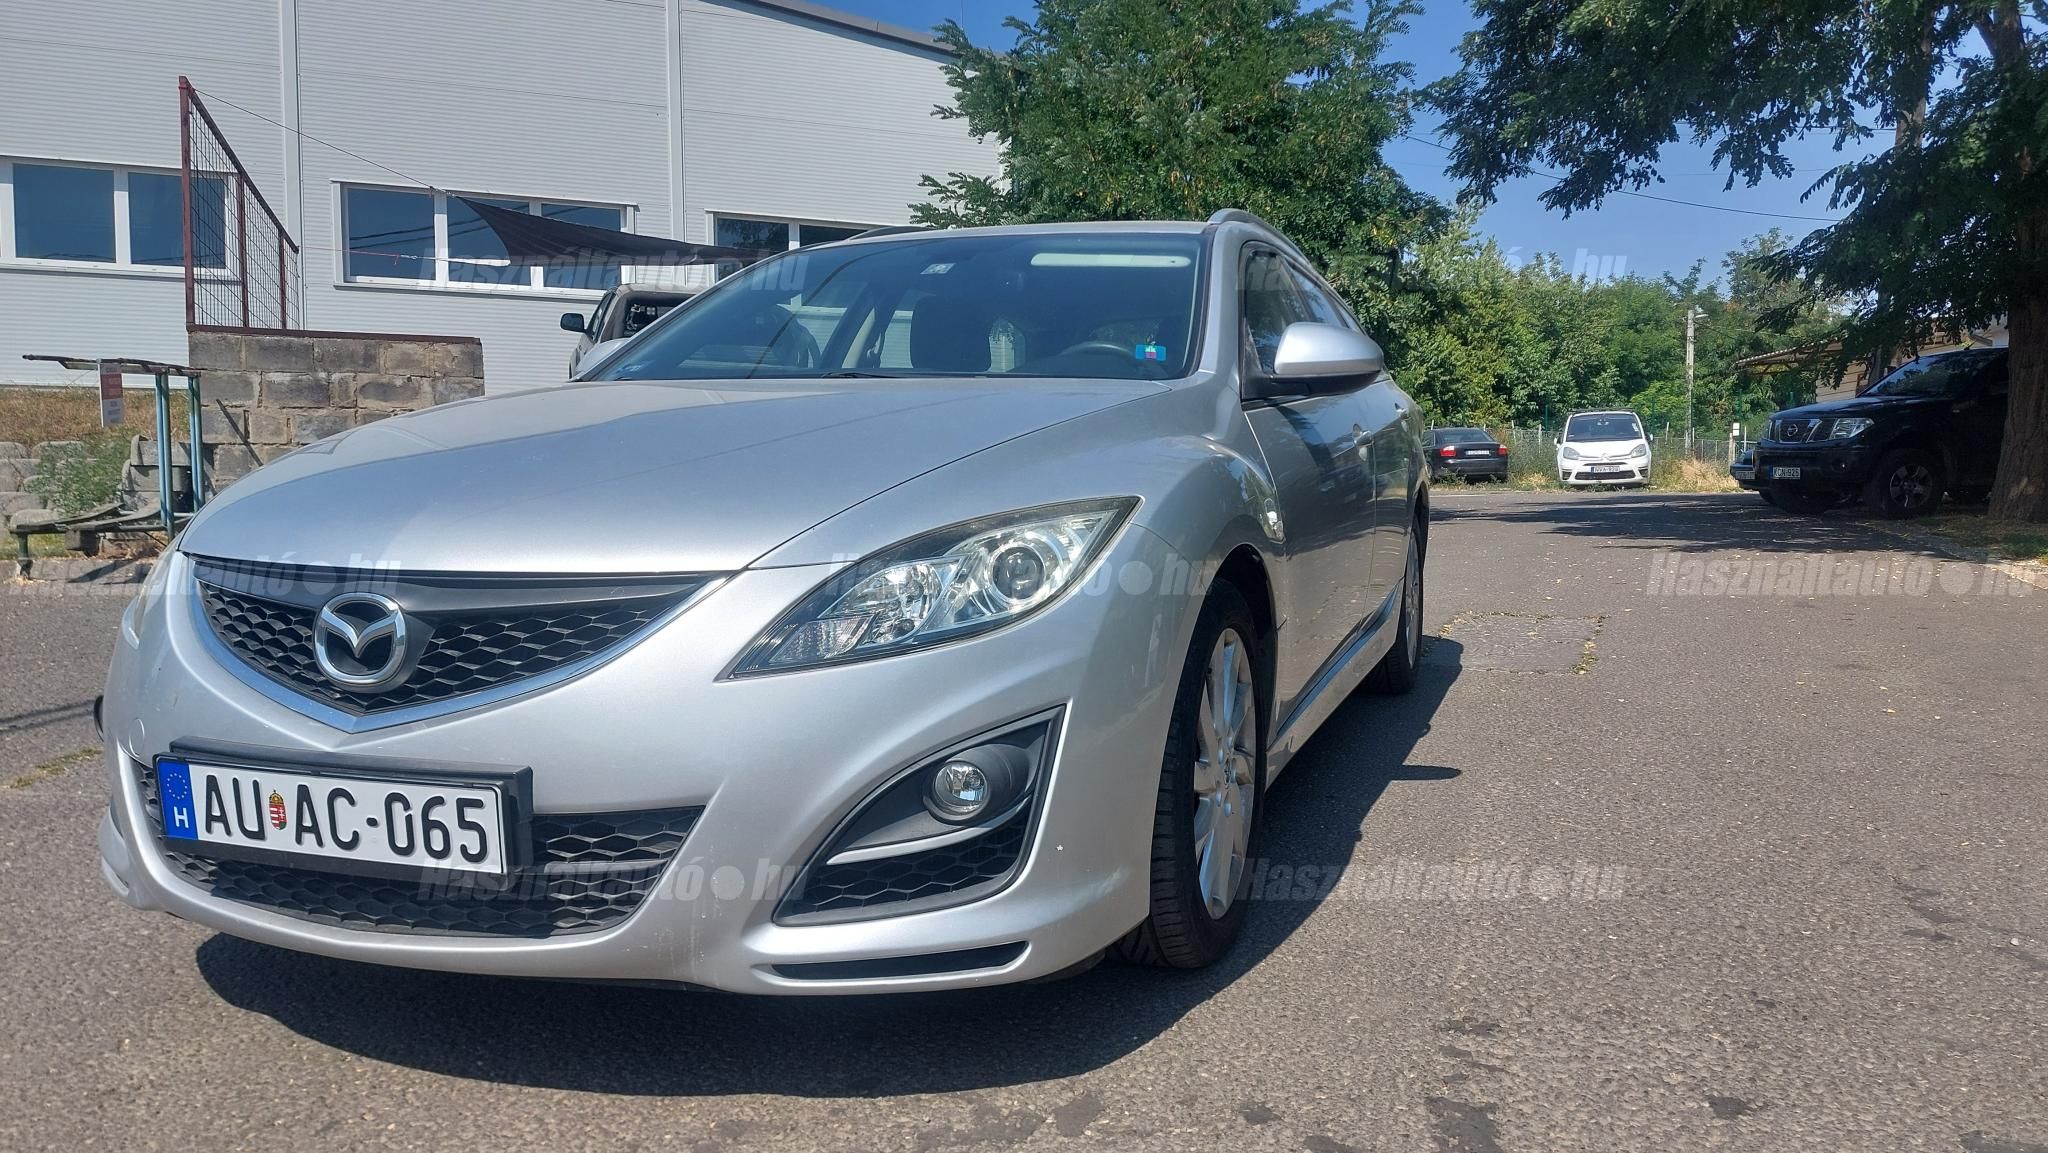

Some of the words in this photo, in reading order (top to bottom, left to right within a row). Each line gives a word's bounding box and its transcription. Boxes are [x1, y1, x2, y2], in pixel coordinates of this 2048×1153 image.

[173, 806, 190, 829] H
[205, 774, 267, 841] AU
[294, 784, 488, 863] AC-065
